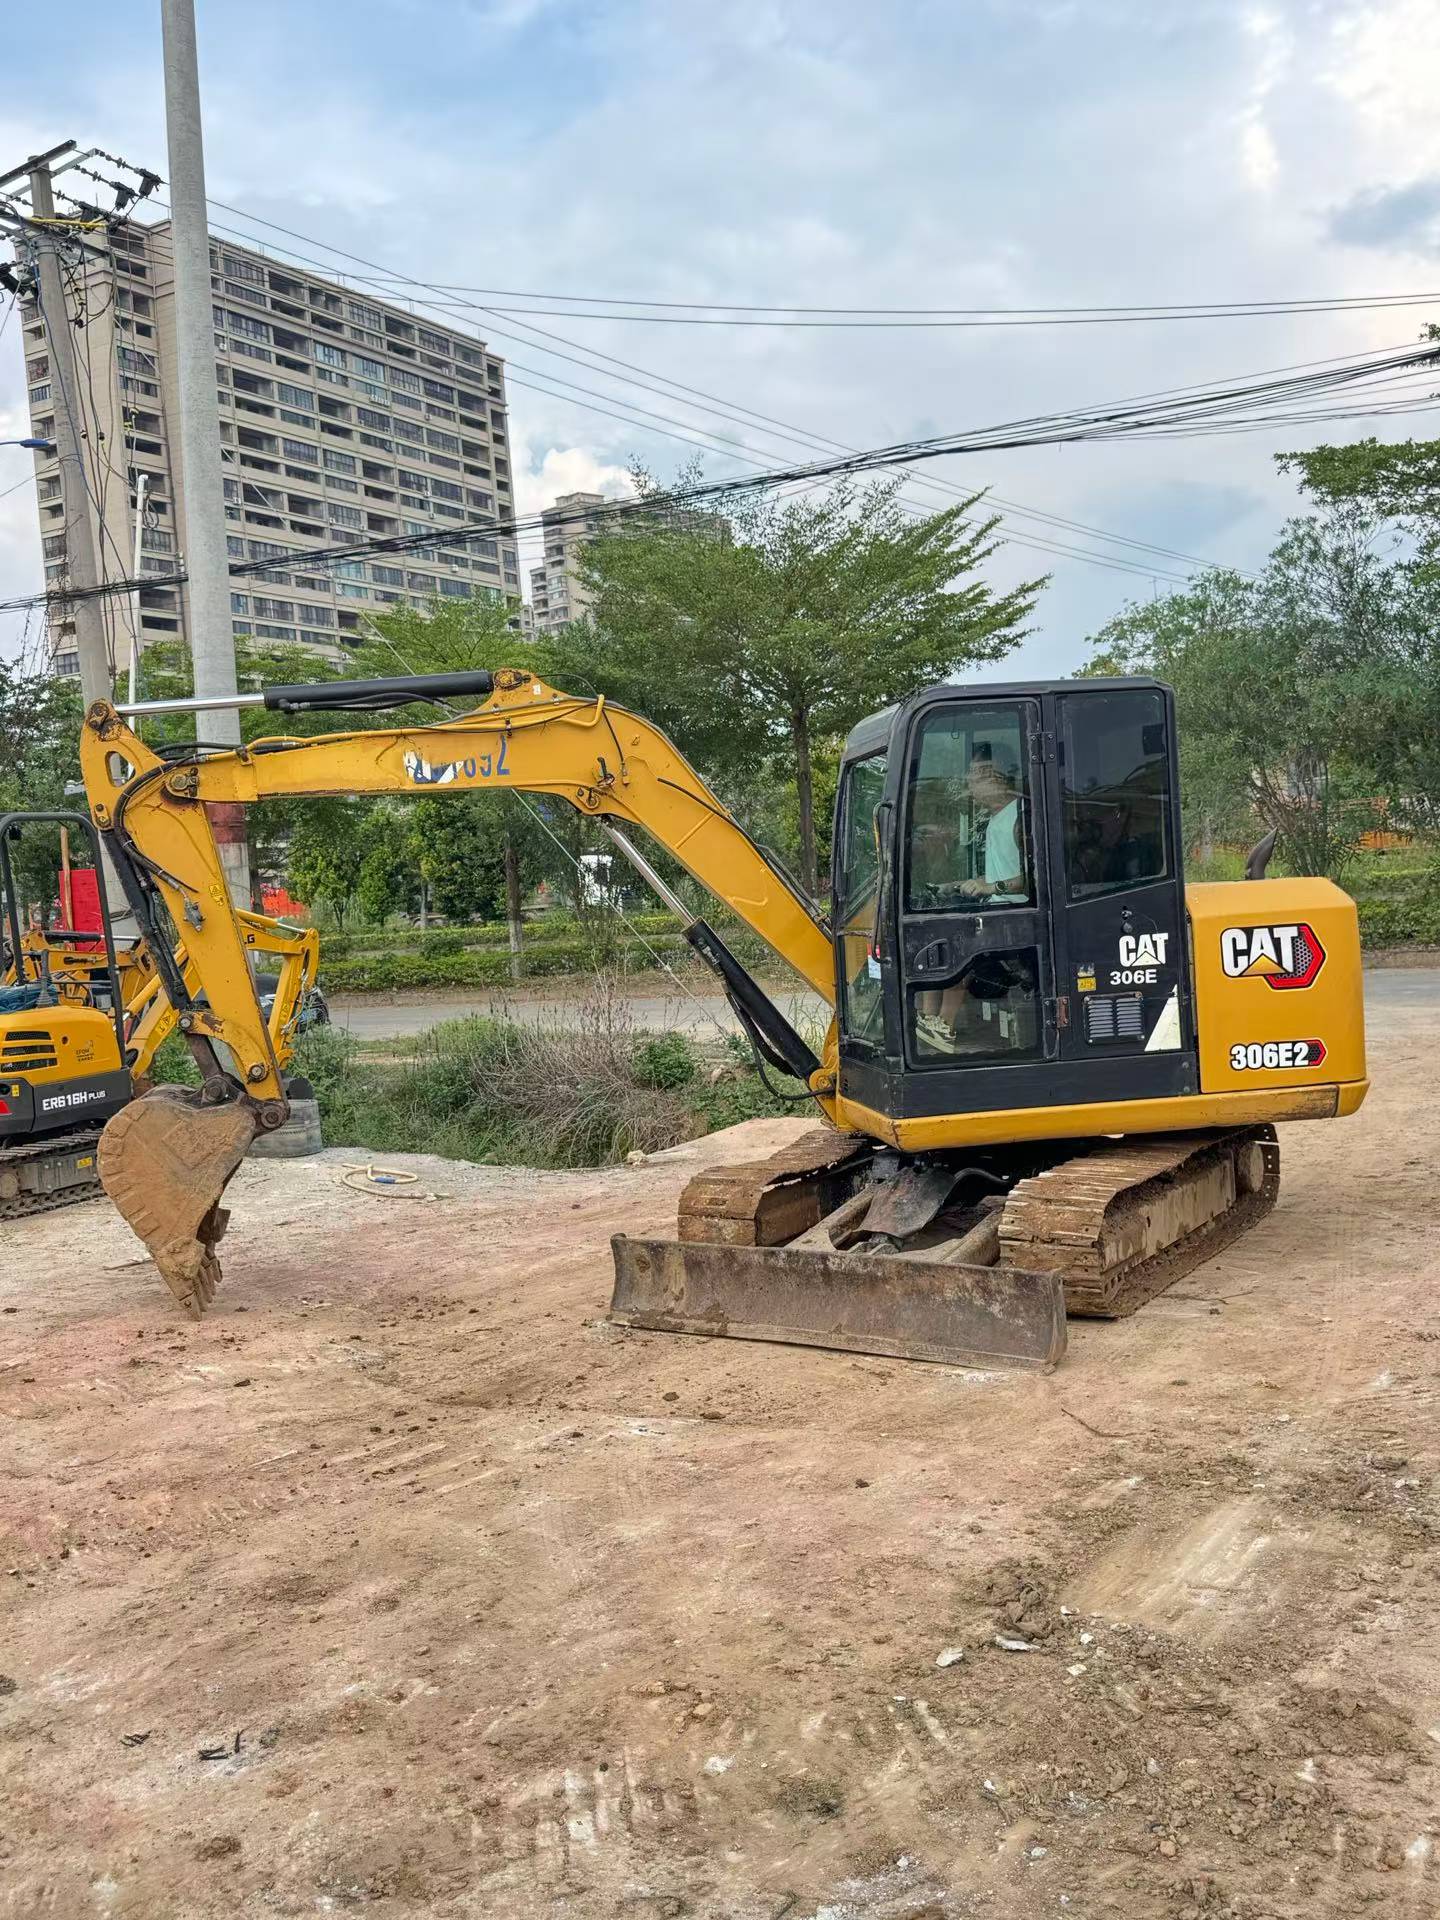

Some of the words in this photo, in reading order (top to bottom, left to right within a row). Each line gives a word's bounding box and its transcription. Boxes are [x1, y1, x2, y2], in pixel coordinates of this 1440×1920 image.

[1118, 932, 1169, 968] CAT
[1222, 926, 1299, 977] CAT
[1109, 968, 1158, 986] 306E
[1230, 1042, 1310, 1071] 306E2
[41, 1091, 88, 1112] ER616H
[88, 1090, 107, 1101] PLUS
